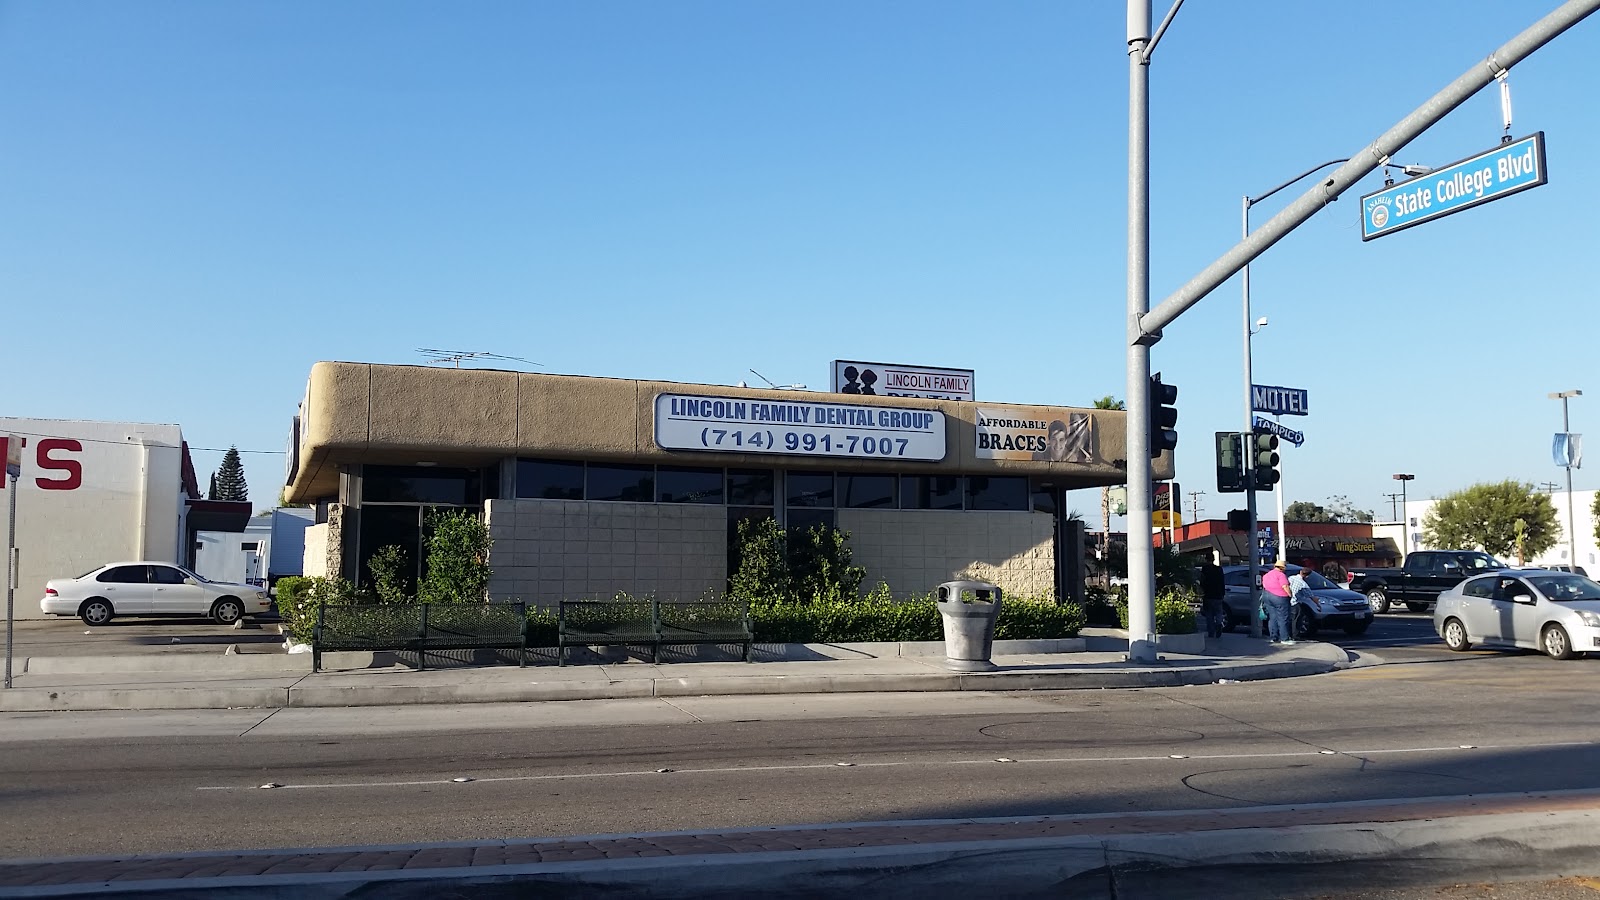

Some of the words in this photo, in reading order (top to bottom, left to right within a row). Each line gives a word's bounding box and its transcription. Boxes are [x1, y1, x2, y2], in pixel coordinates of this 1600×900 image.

[1396, 187, 1432, 217] State
[1436, 167, 1493, 203] College
[1497, 146, 1533, 182] Blvd
[1367, 196, 1392, 213] ANAHEIM
[886, 373, 931, 389] LINCOLN
[934, 377, 970, 391] FAMILY
[1252, 386, 1308, 413] MOTEL
[671, 398, 746, 420] LINCOLN
[751, 403, 811, 423] FAMILY
[815, 407, 875, 427] DENTAL
[878, 410, 934, 429] GROUP
[979, 418, 1047, 430] AFFORDABLE
[1257, 418, 1303, 443] TAMPICO
[701, 427, 774, 450] (714)
[784, 431, 909, 456] 991-7007
[978, 432, 1047, 452] BRACES
[1155, 491, 1170, 505] Pizz
[1335, 542, 1375, 553] WingStreet
